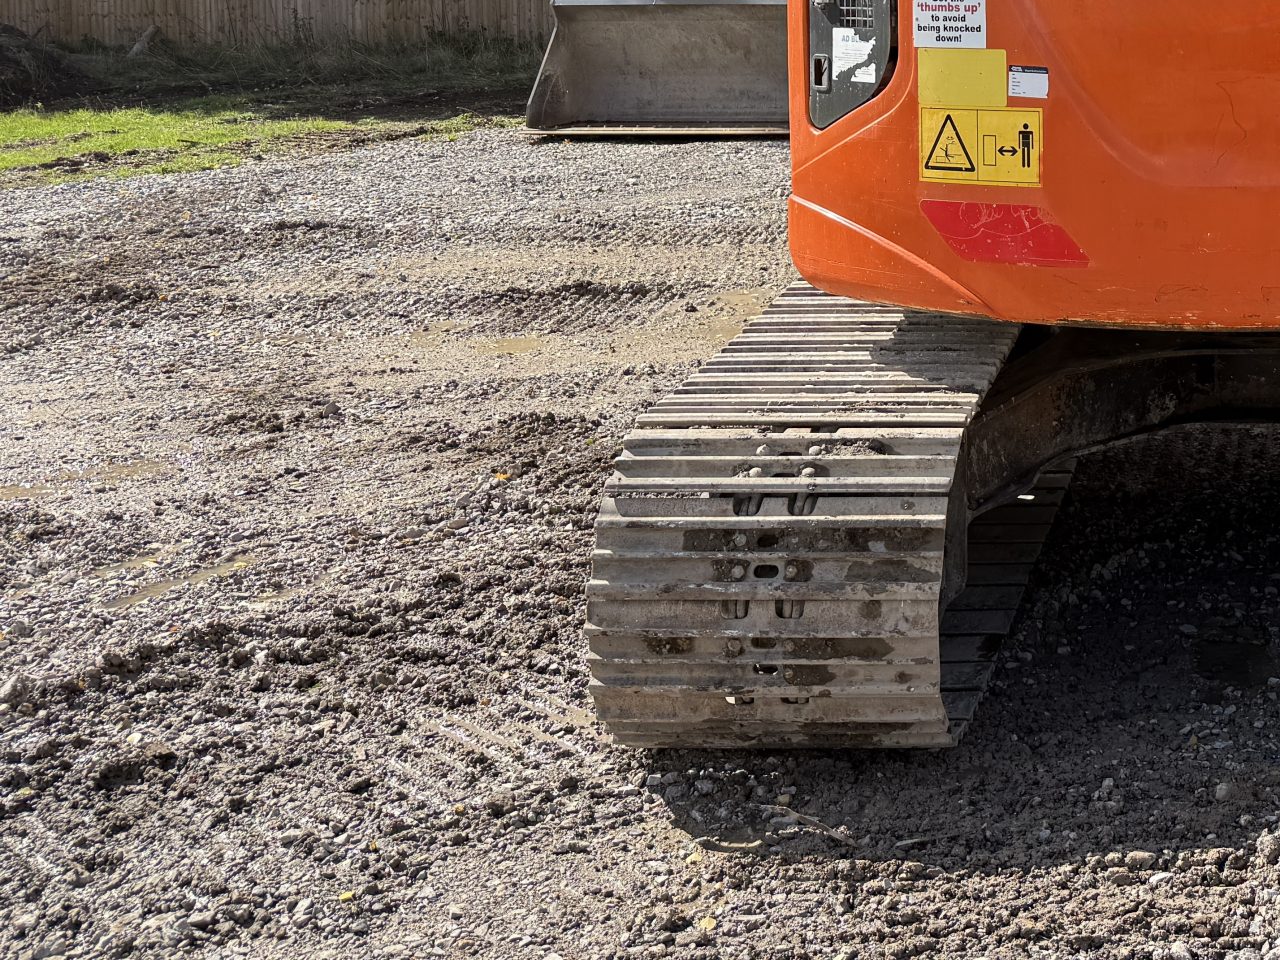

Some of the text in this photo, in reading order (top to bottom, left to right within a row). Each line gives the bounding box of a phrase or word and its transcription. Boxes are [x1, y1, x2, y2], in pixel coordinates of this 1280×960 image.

[931, 14, 966, 22] to avoid
[917, 24, 981, 33] being knocked
[935, 34, 962, 42] down!
